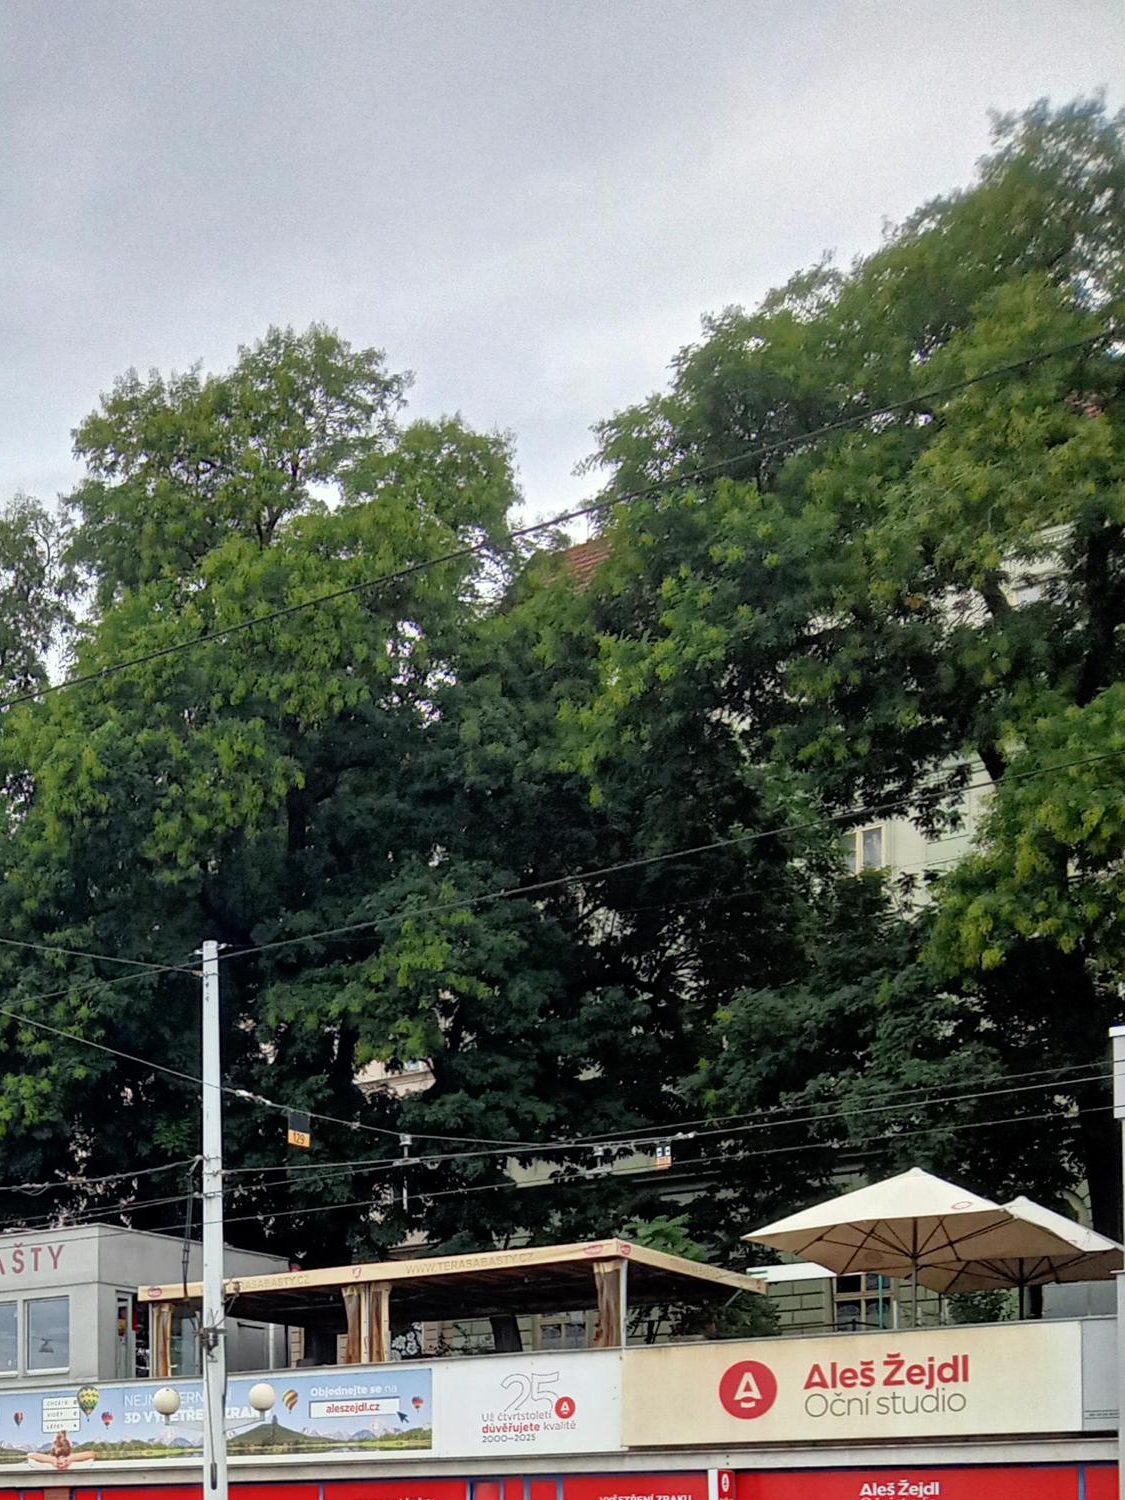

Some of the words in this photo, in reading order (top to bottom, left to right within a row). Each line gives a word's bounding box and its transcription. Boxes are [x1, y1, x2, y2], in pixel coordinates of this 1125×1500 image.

[803, 1359, 876, 1390] Aleš
[882, 1352, 969, 1389] Žejdl
[310, 1385, 368, 1398] Objednejte
[370, 1386, 381, 1394] se
[384, 1385, 398, 1393] na
[500, 1371, 560, 1412] 25
[326, 1402, 380, 1414] aleszejdl.cz
[804, 1391, 870, 1418] Oční
[875, 1387, 967, 1415] studio
[123, 1411, 141, 1424] 3D
[481, 1412, 495, 1422] Už
[497, 1410, 552, 1421] čtvrtstoletí
[481, 1422, 540, 1434] důvěřujete
[543, 1420, 577, 1431] kvalitě
[859, 1482, 895, 1496] Aleš
[897, 1479, 940, 1498] Žejdl
